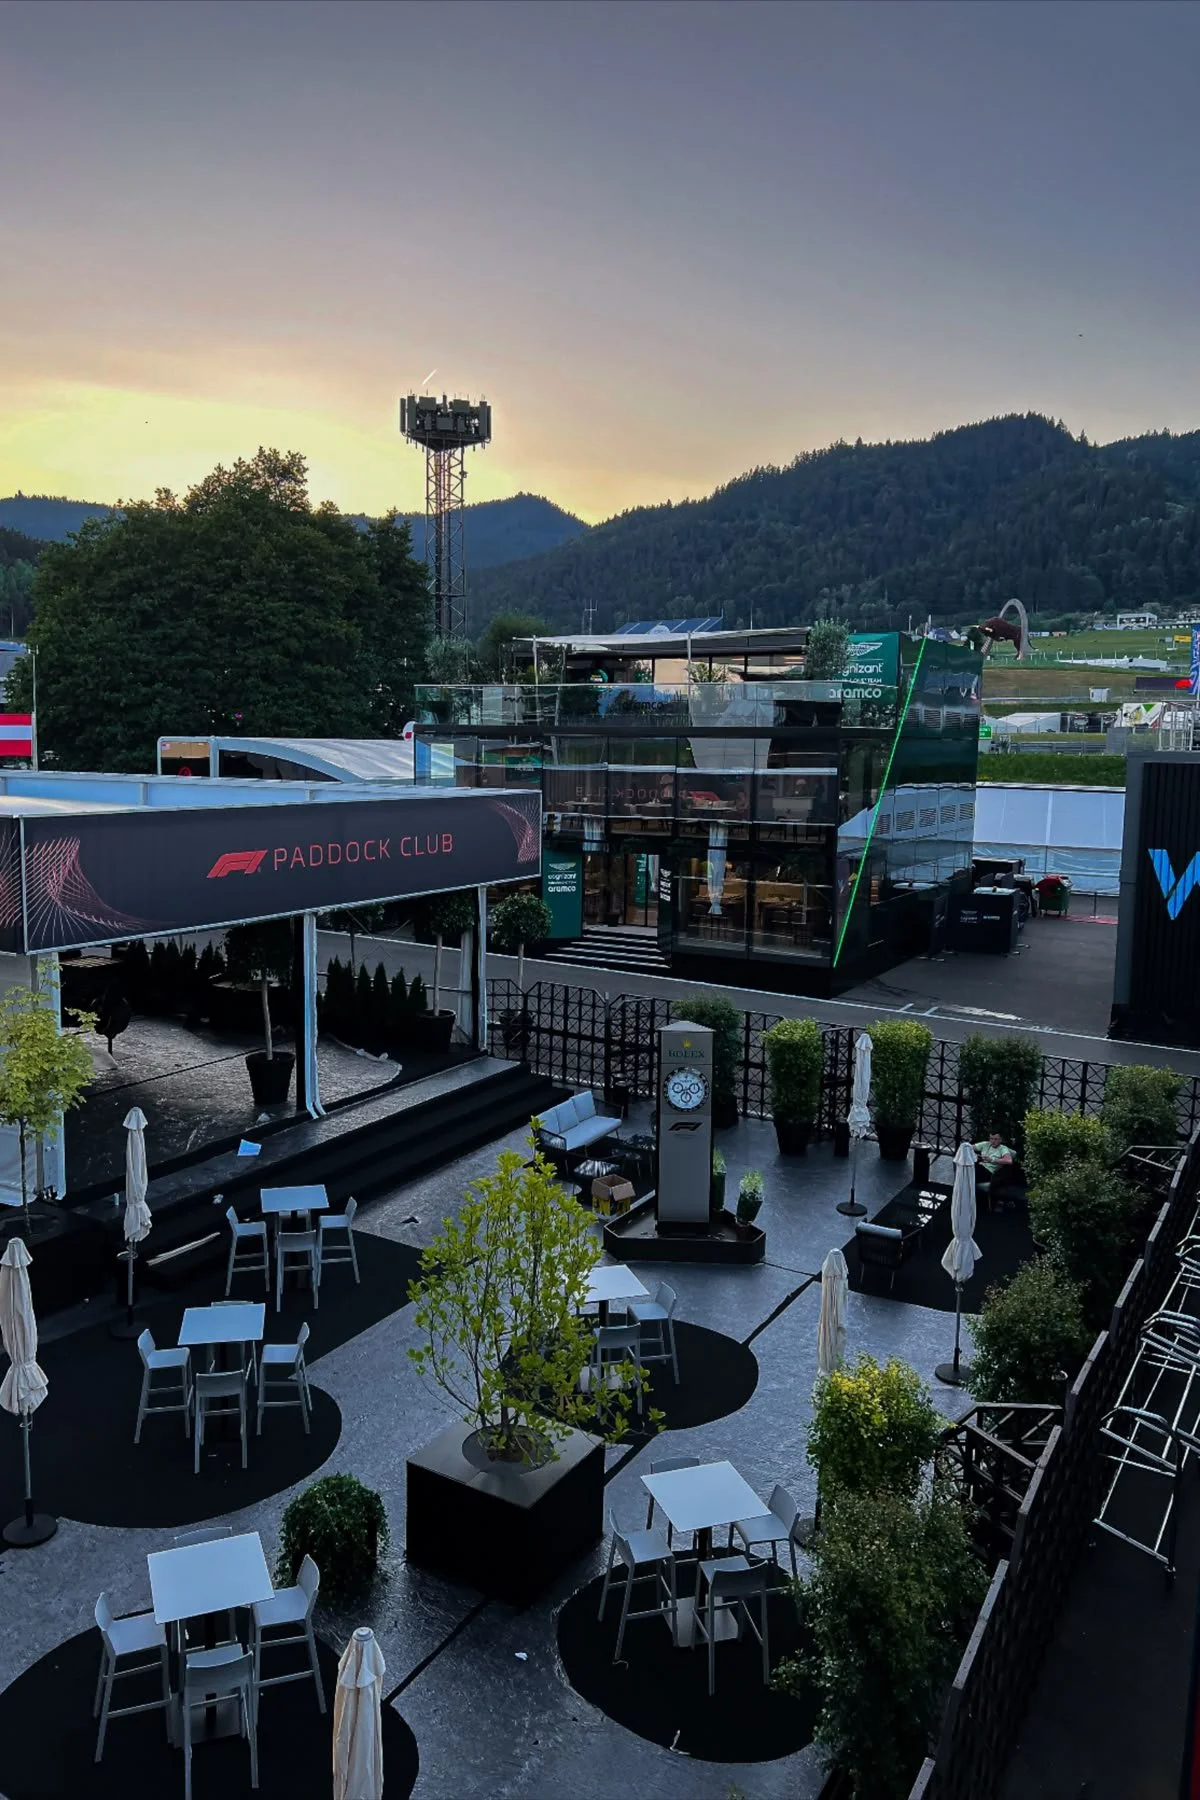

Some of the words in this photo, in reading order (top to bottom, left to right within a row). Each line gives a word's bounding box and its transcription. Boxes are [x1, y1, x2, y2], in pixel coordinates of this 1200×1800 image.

[829, 687, 882, 699] aramco
[273, 838, 391, 871] PADDOCK
[400, 833, 454, 857] CLUB
[668, 1049, 705, 1059] ROLEX
